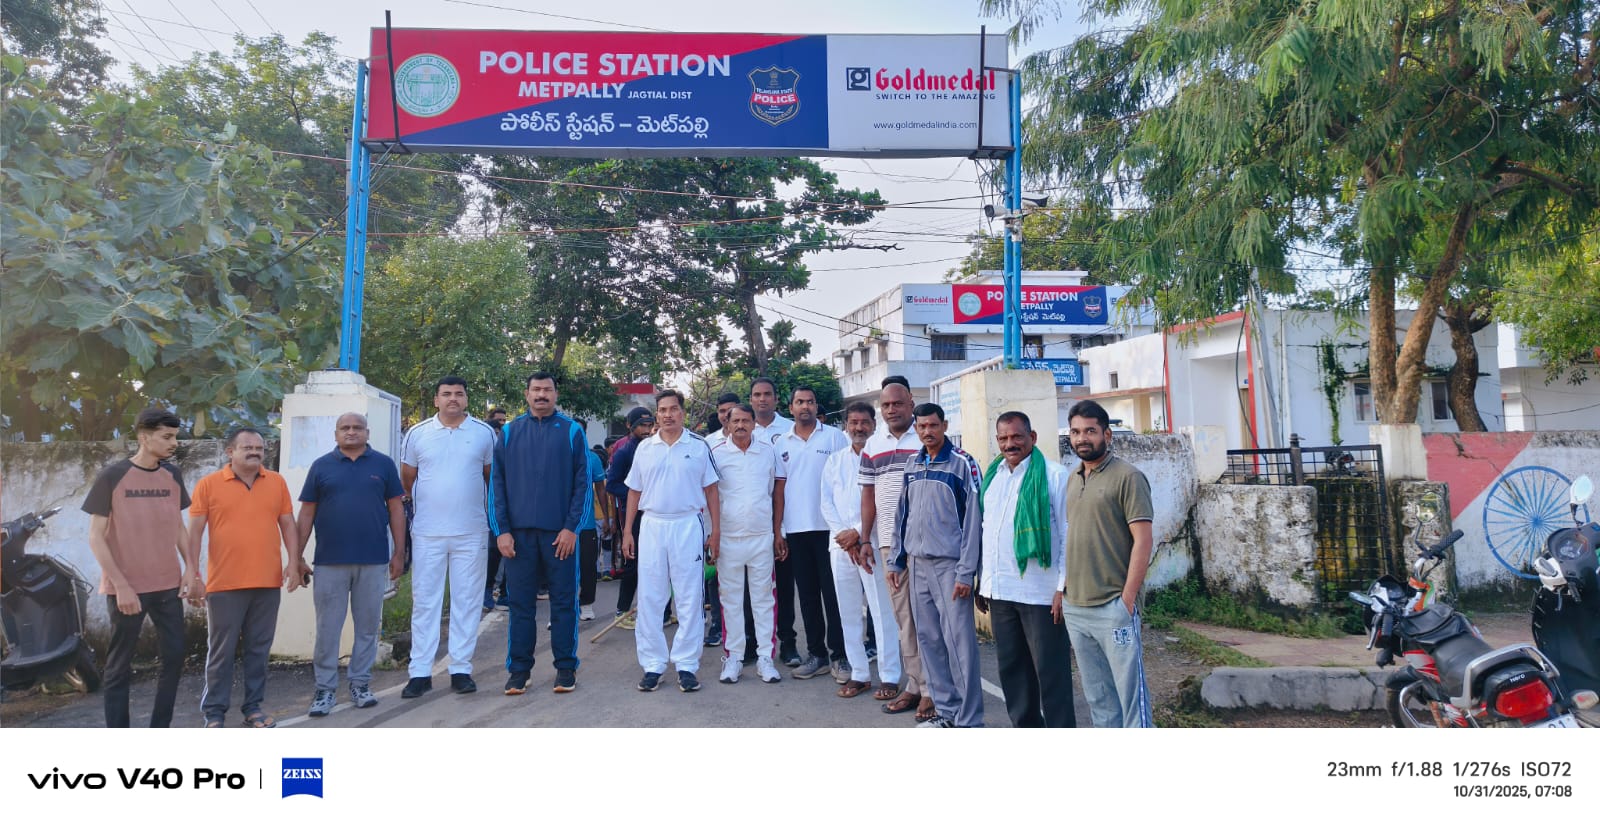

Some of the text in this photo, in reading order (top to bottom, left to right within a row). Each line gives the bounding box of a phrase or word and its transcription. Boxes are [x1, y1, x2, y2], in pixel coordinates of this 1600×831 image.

[479, 51, 731, 77] POLICE STATION
[875, 67, 995, 91] Goldmedal
[518, 81, 692, 100] METPALLY JAGTIAL DIST
[754, 93, 796, 104] POLICE
[500, 111, 560, 132] పోలీస్
[565, 112, 615, 140] స్టేషన్
[873, 121, 977, 130] www.goldmedalindia.com
[986, 291, 1078, 302] POE STATION
[1019, 302, 1054, 310] ETPALLY
